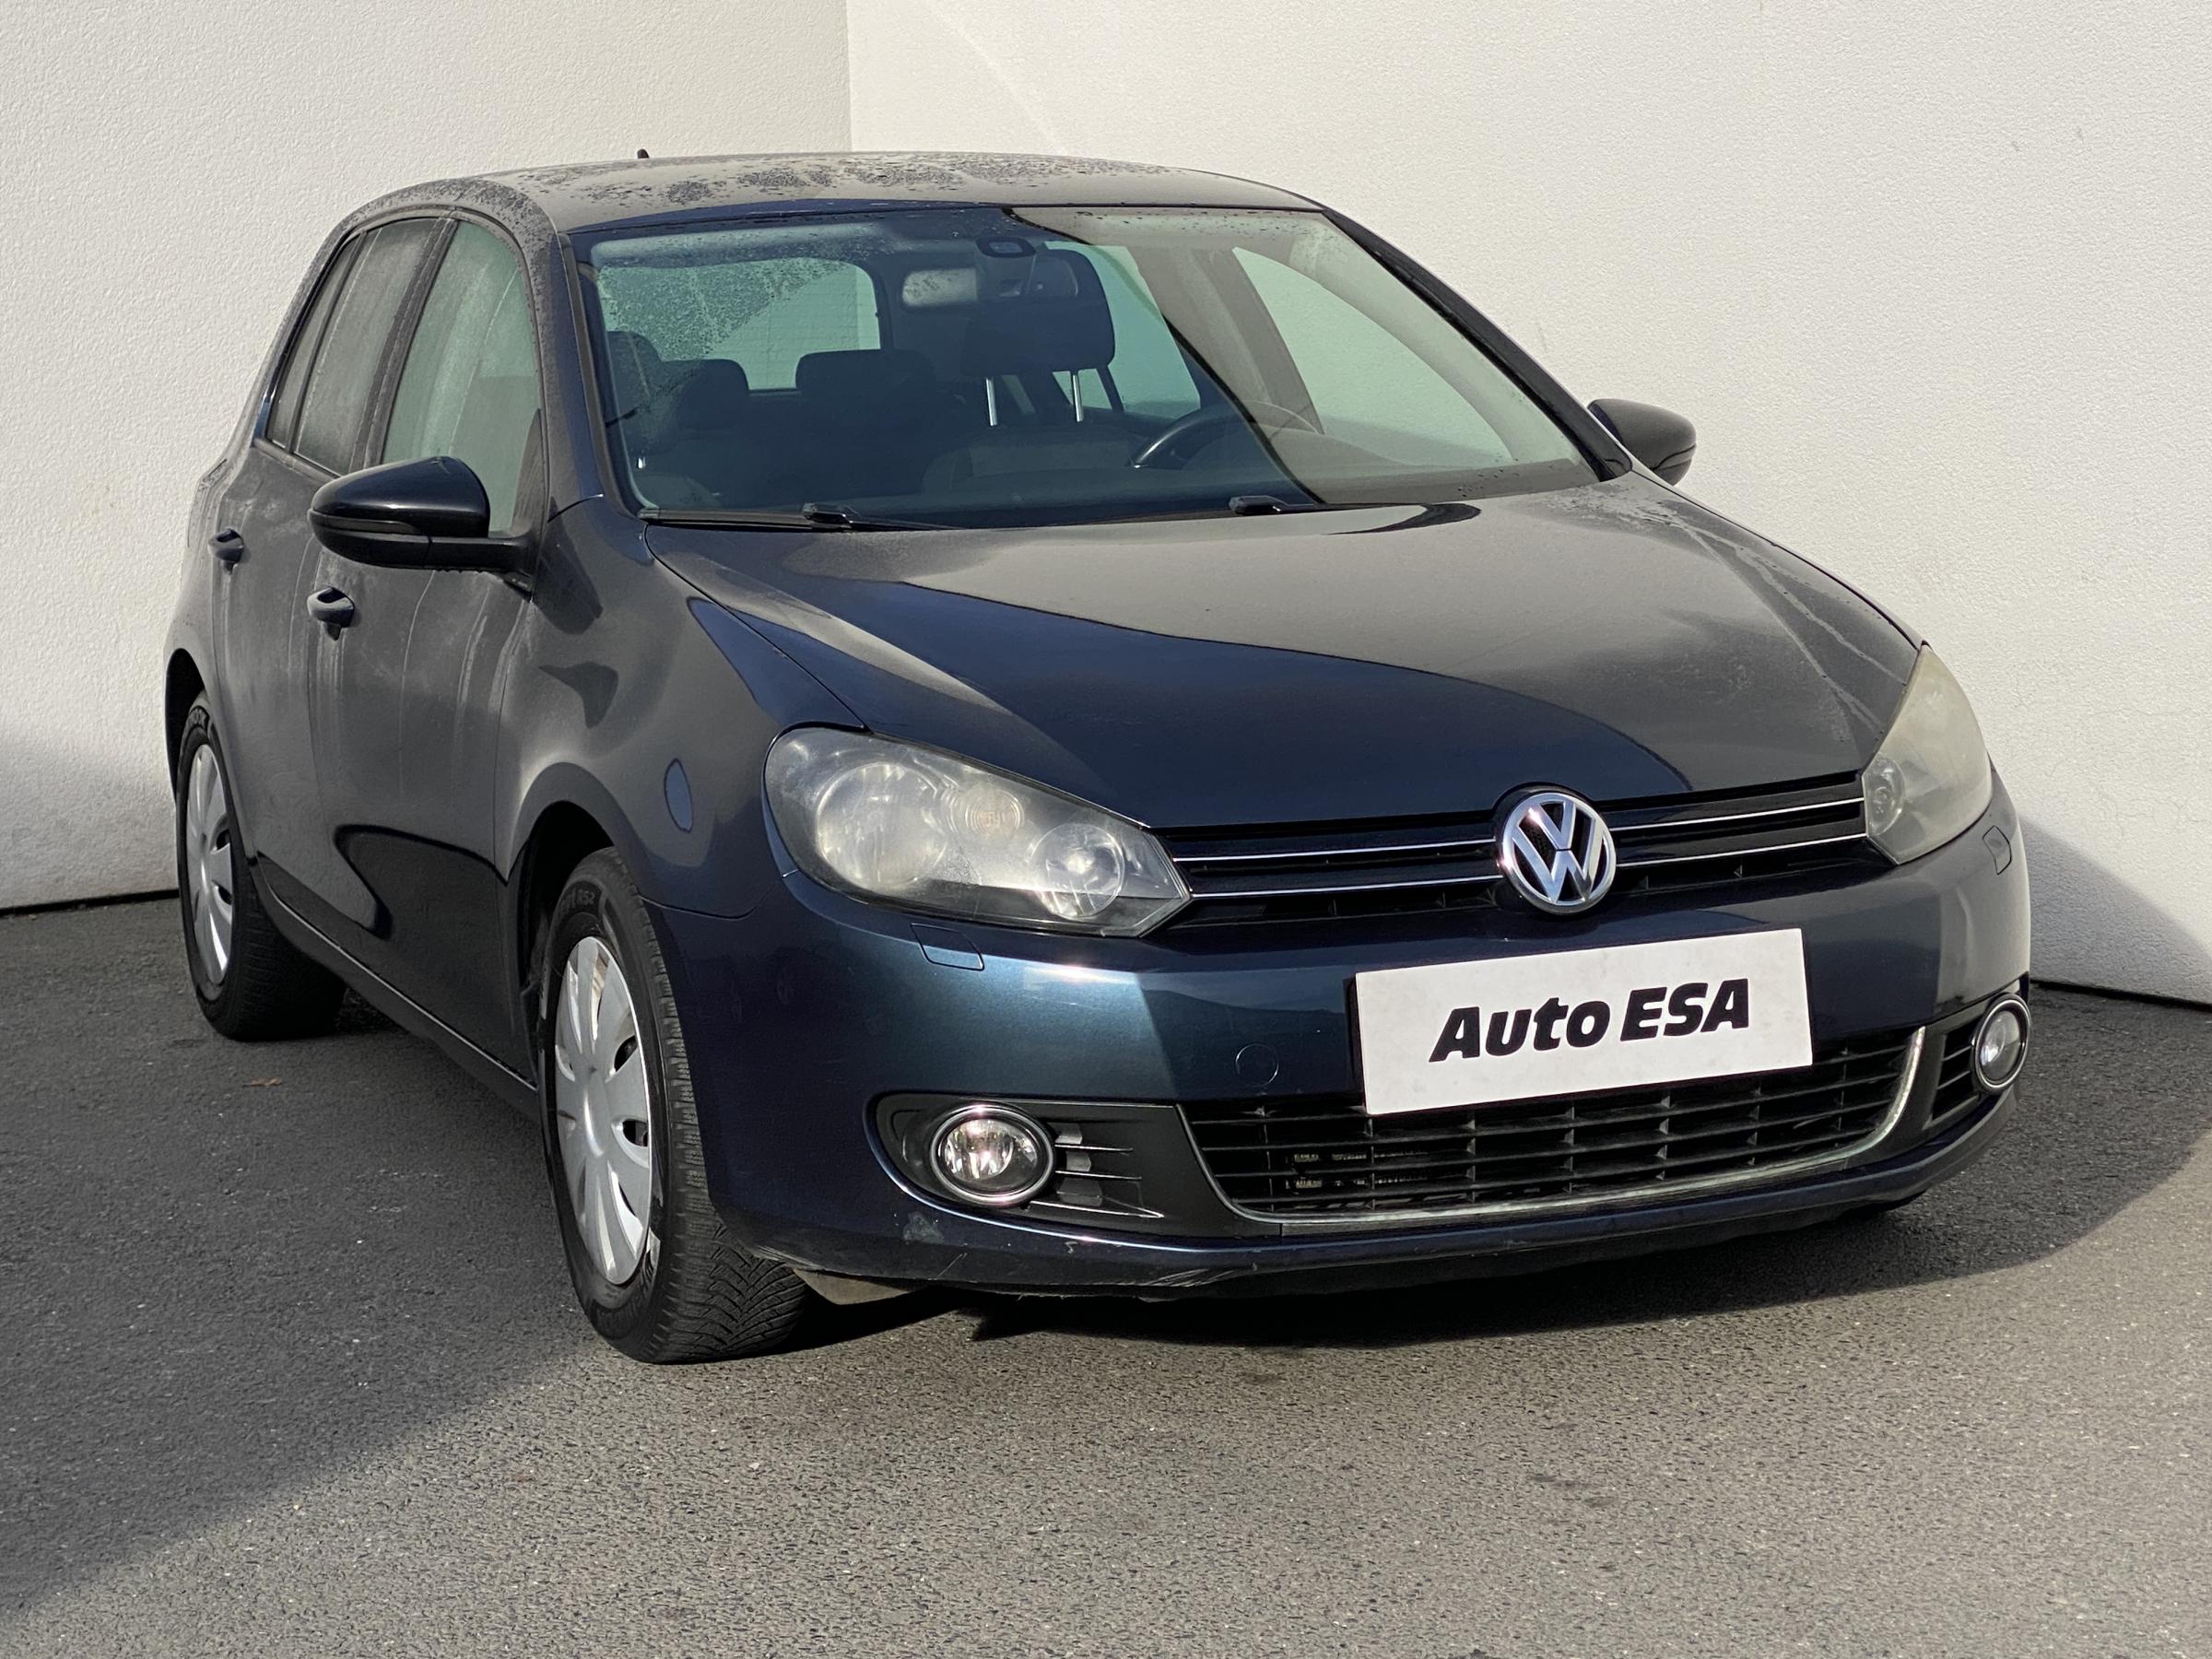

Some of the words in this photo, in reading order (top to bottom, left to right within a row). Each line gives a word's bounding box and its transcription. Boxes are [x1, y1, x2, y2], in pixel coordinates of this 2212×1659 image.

[1505, 794, 1613, 910] VW
[1429, 997, 1611, 1063] Auto
[1619, 978, 1749, 1041] ESA
